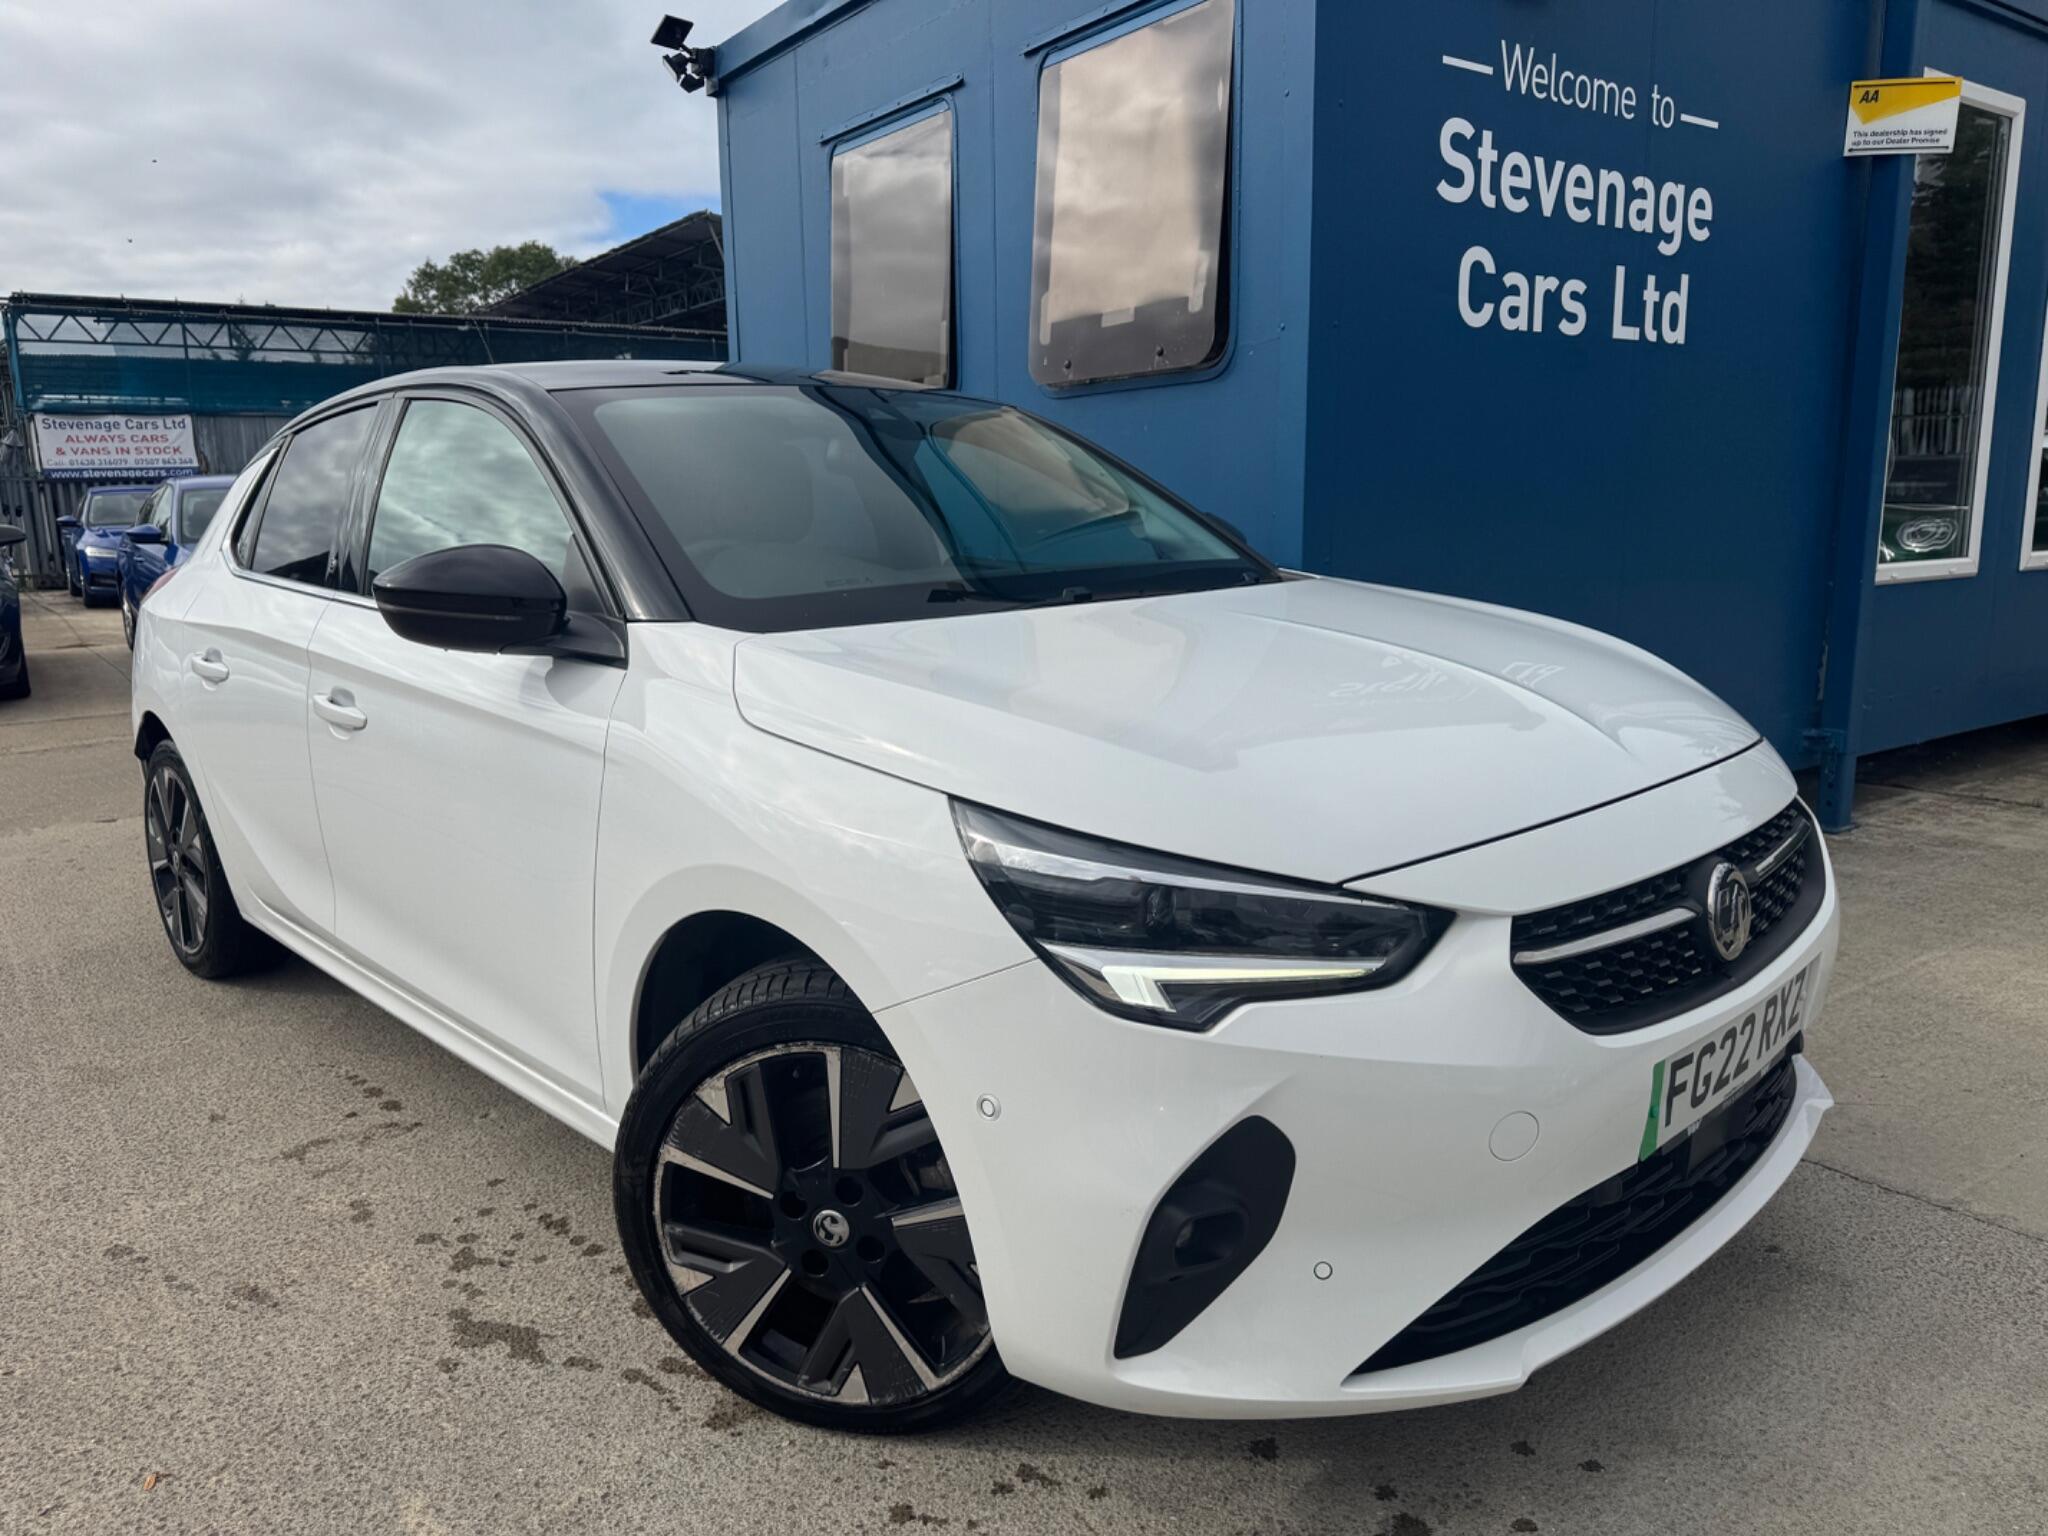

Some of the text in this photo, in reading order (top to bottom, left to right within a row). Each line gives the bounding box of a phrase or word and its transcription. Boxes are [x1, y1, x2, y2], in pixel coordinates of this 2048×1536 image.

[1501, 39, 1675, 128] Welcome to
[1859, 90, 1879, 104] AA
[1869, 129, 1908, 138] dealership
[1923, 128, 1948, 137] signed
[1911, 136, 1941, 144] Promise
[1436, 117, 1713, 256] Stevenage
[1458, 245, 1689, 344] Cars Ltd
[42, 417, 187, 432] Stevenage Cars Ltd
[65, 433, 169, 443] ALWAYS CARS
[55, 446, 183, 456] & VANS IN STOCK
[51, 468, 193, 478] www.stevenagecars.com
[1664, 966, 1807, 1128] FG22 RXZ
